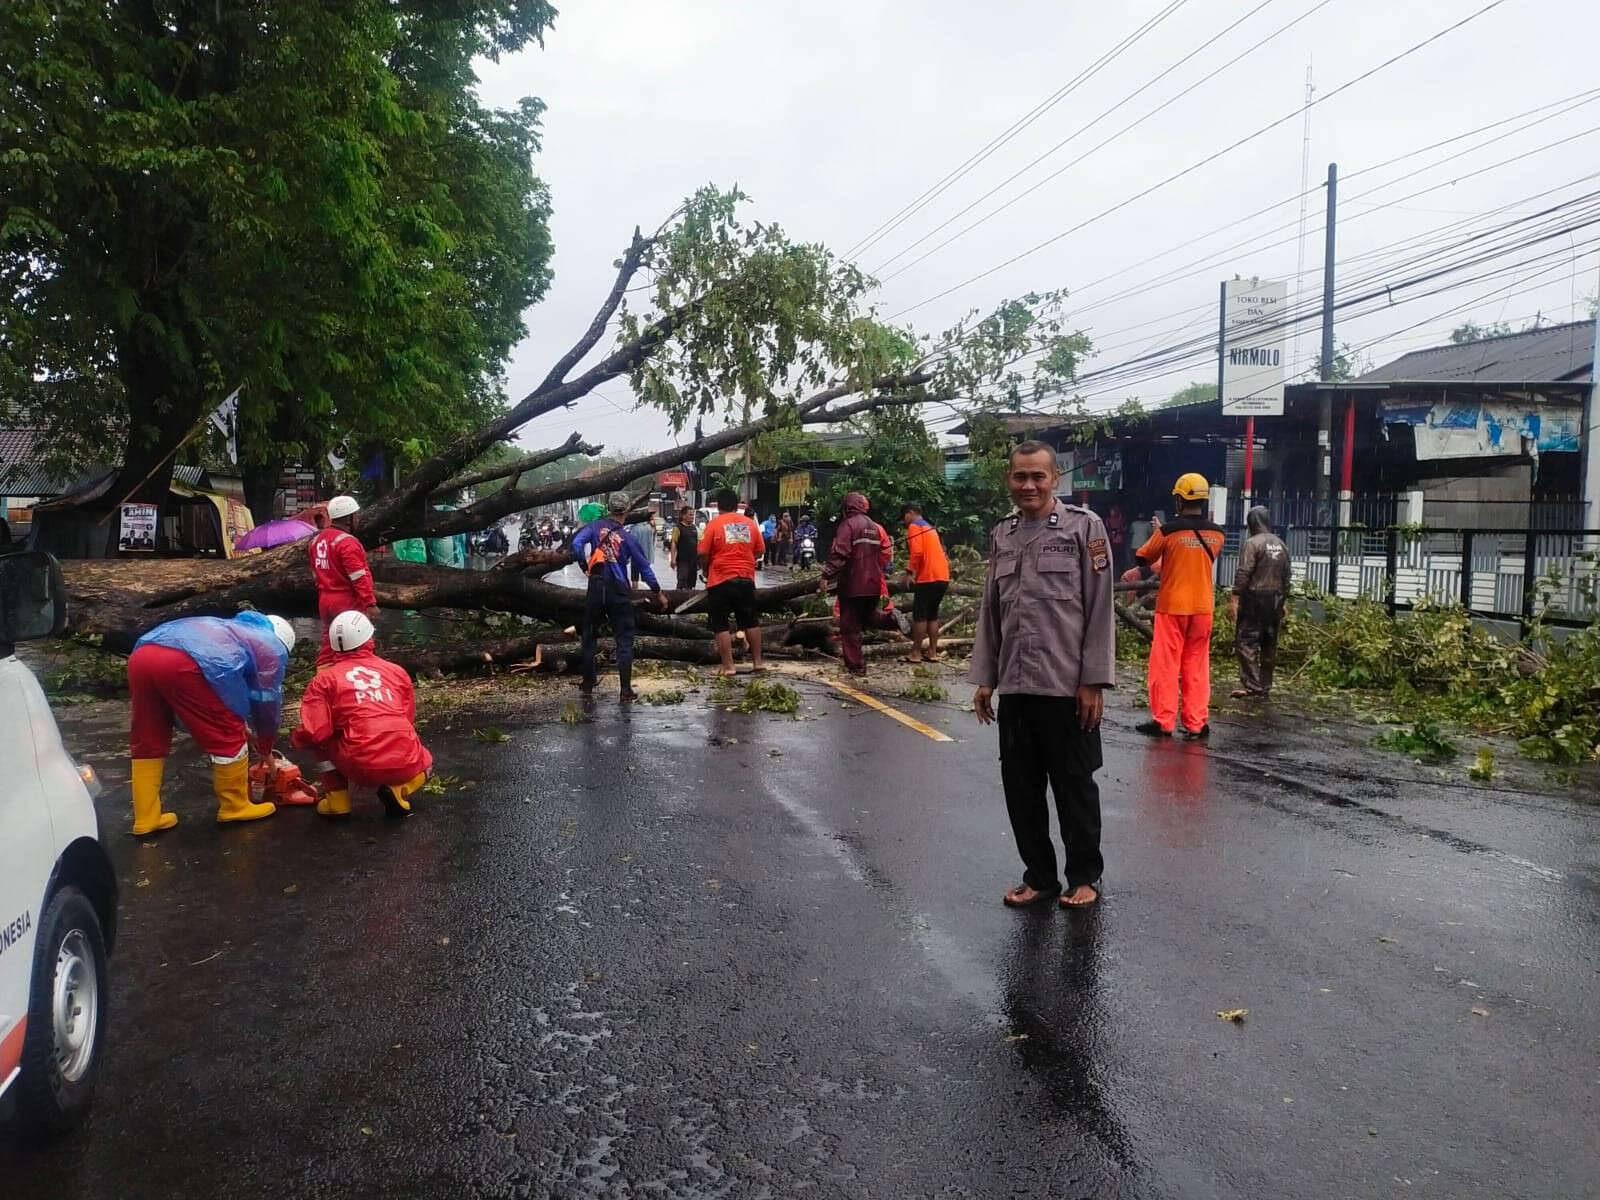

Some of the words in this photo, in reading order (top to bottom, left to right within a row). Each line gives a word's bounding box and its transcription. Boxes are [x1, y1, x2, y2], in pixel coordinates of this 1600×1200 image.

[1230, 348, 1280, 366] NIRMOLO
[315, 558, 330, 570] PMI
[355, 688, 393, 704] PMI
